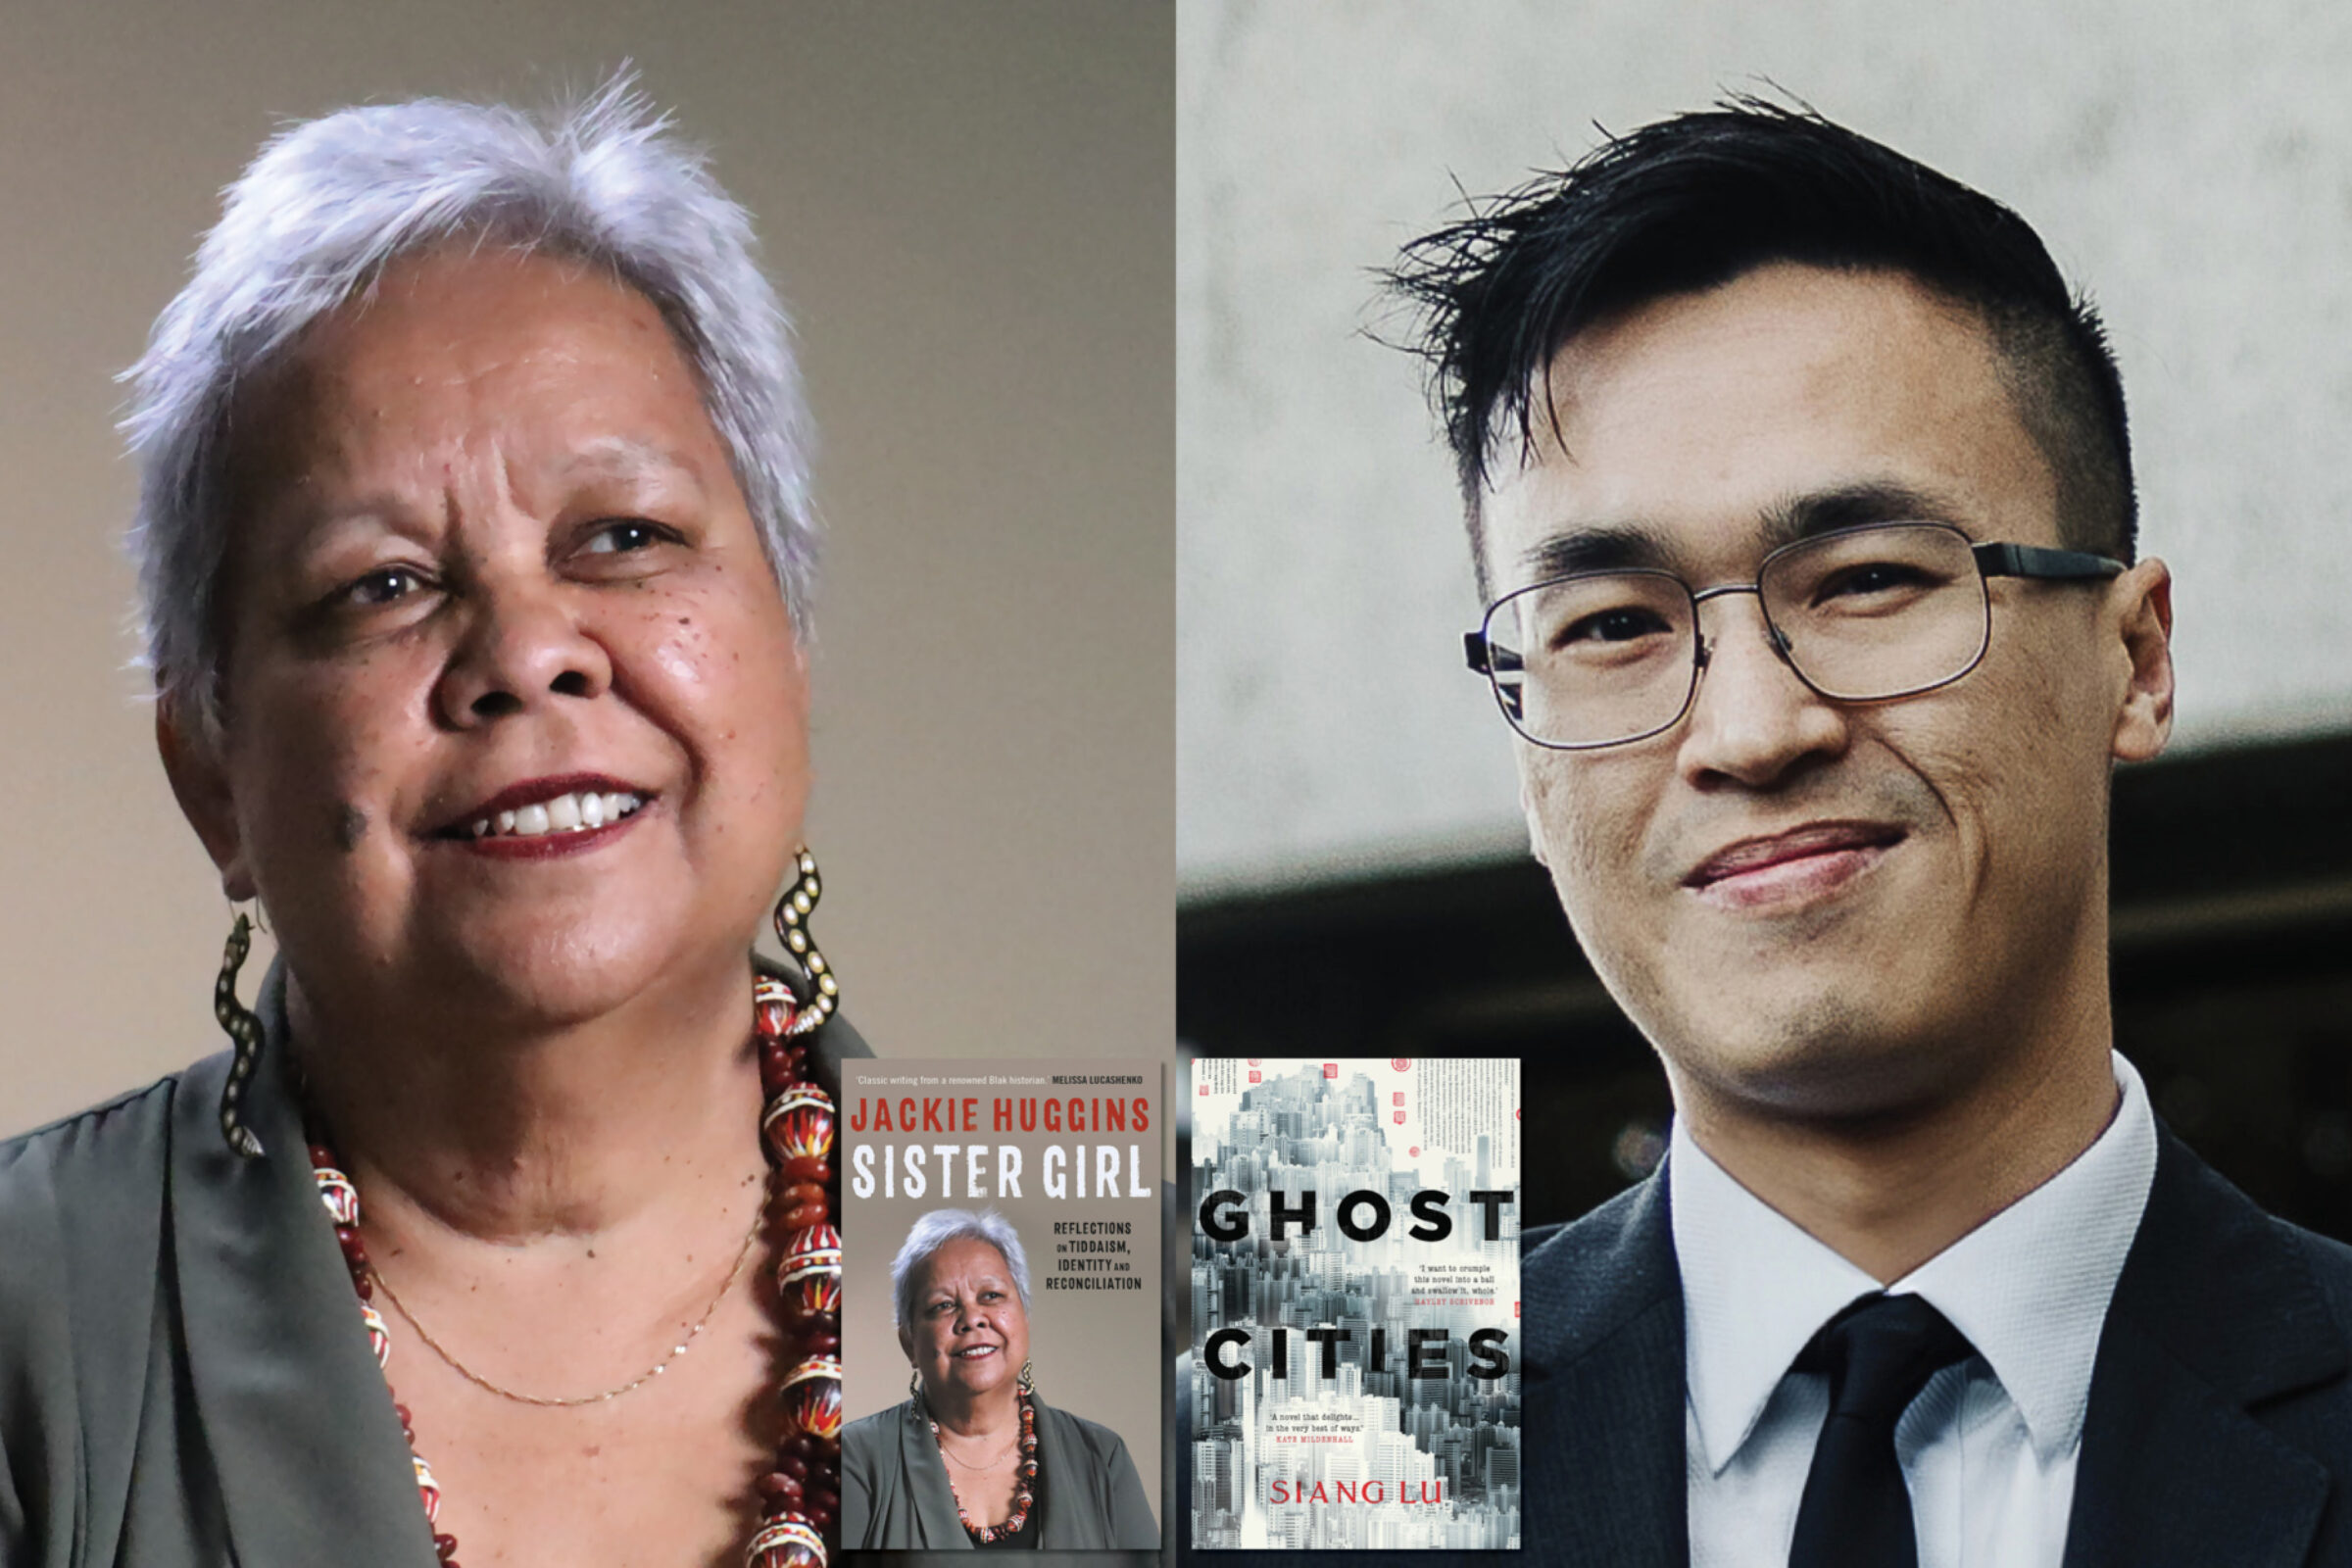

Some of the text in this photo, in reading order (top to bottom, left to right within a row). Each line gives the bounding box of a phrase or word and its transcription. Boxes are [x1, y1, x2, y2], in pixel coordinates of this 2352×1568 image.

[890, 1075, 918, 1087] writing
[920, 1075, 939, 1085] from
[949, 1075, 987, 1085] renowned
[989, 1075, 1007, 1085] Blak
[1052, 1075, 1143, 1085] MELISSA LUCASHENKO
[851, 1098, 1150, 1133] JACKIE HUGGINS
[853, 1145, 1152, 1200] SISTER GIRL
[1200, 1190, 1514, 1243] GHOST
[1054, 1222, 1132, 1235] REFLECTIONS
[1056, 1240, 1131, 1255] ON TIDDAISM,
[1058, 1258, 1130, 1271] IDENTITY AND
[1459, 1264, 1490, 1274] crumple
[1046, 1277, 1142, 1290] RECONCILIATION
[1203, 1328, 1509, 1381] CITIES
[1270, 1481, 1442, 1503] SIANG LU
